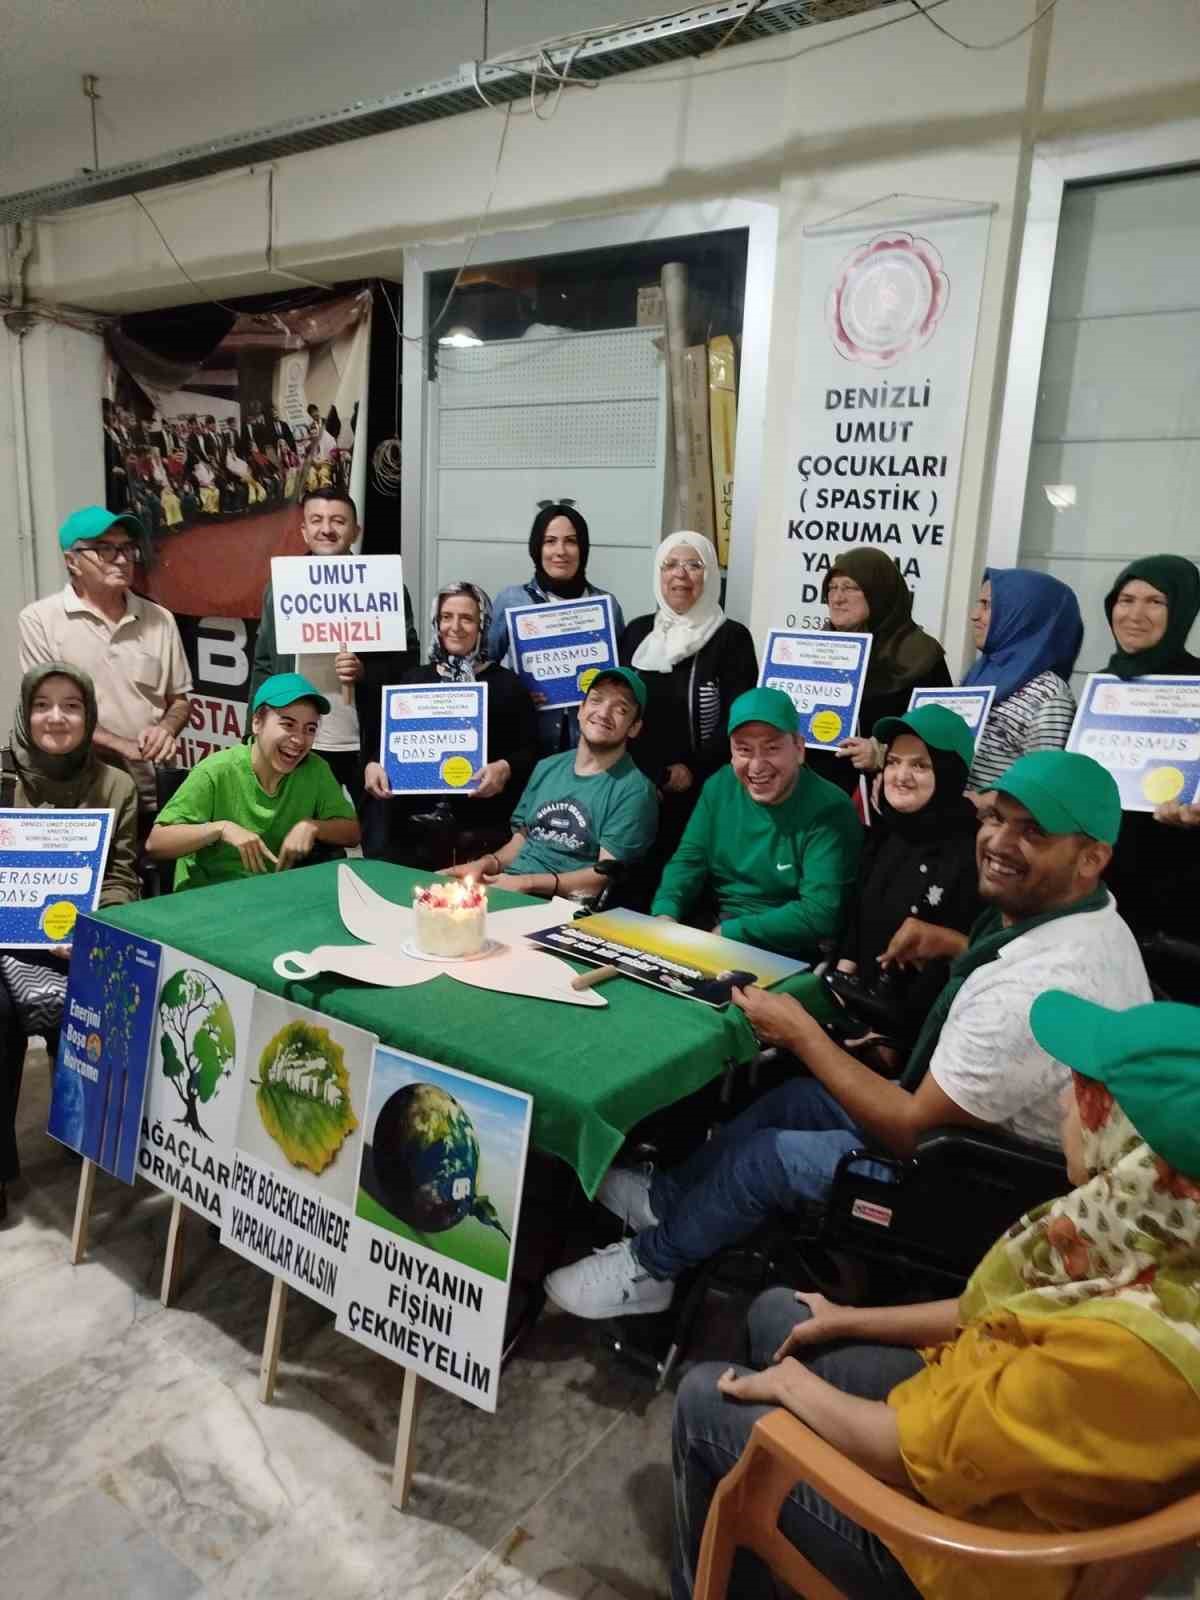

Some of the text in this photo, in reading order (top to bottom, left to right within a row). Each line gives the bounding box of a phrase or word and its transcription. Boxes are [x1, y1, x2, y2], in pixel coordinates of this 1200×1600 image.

[825, 378, 931, 410] DENİZLİ
[835, 421, 914, 443] UMUT
[797, 455, 947, 481] ÇOCUKLARI
[815, 483, 921, 511] SPASTİK
[787, 519, 945, 546] KORUMA VE
[308, 563, 367, 585] UMUT
[280, 591, 398, 620] ÇOCUKLARI
[302, 615, 382, 643] DENİZLİ
[526, 646, 599, 664] #ERASMUS
[537, 663, 571, 677] DAYS
[190, 697, 242, 738] STA
[392, 734, 467, 745] #ERASMUS
[402, 748, 436, 760] DAYS
[69, 997, 101, 1029] Enerjini
[66, 1023, 87, 1051] Boşa
[63, 1047, 100, 1084] Harcama
[140, 1116, 231, 1190] AĞAÇLAR
[138, 1147, 223, 1219] ORMANA
[231, 1152, 350, 1254] İPEK BÖCEKLERİNEDE
[230, 1205, 339, 1298] YAPRAKLAR KALSIN
[369, 1238, 484, 1313] DÜNYANIN
[388, 1282, 453, 1337] FİŞİNİ
[348, 1301, 491, 1394] ÇEKMEYELİM
